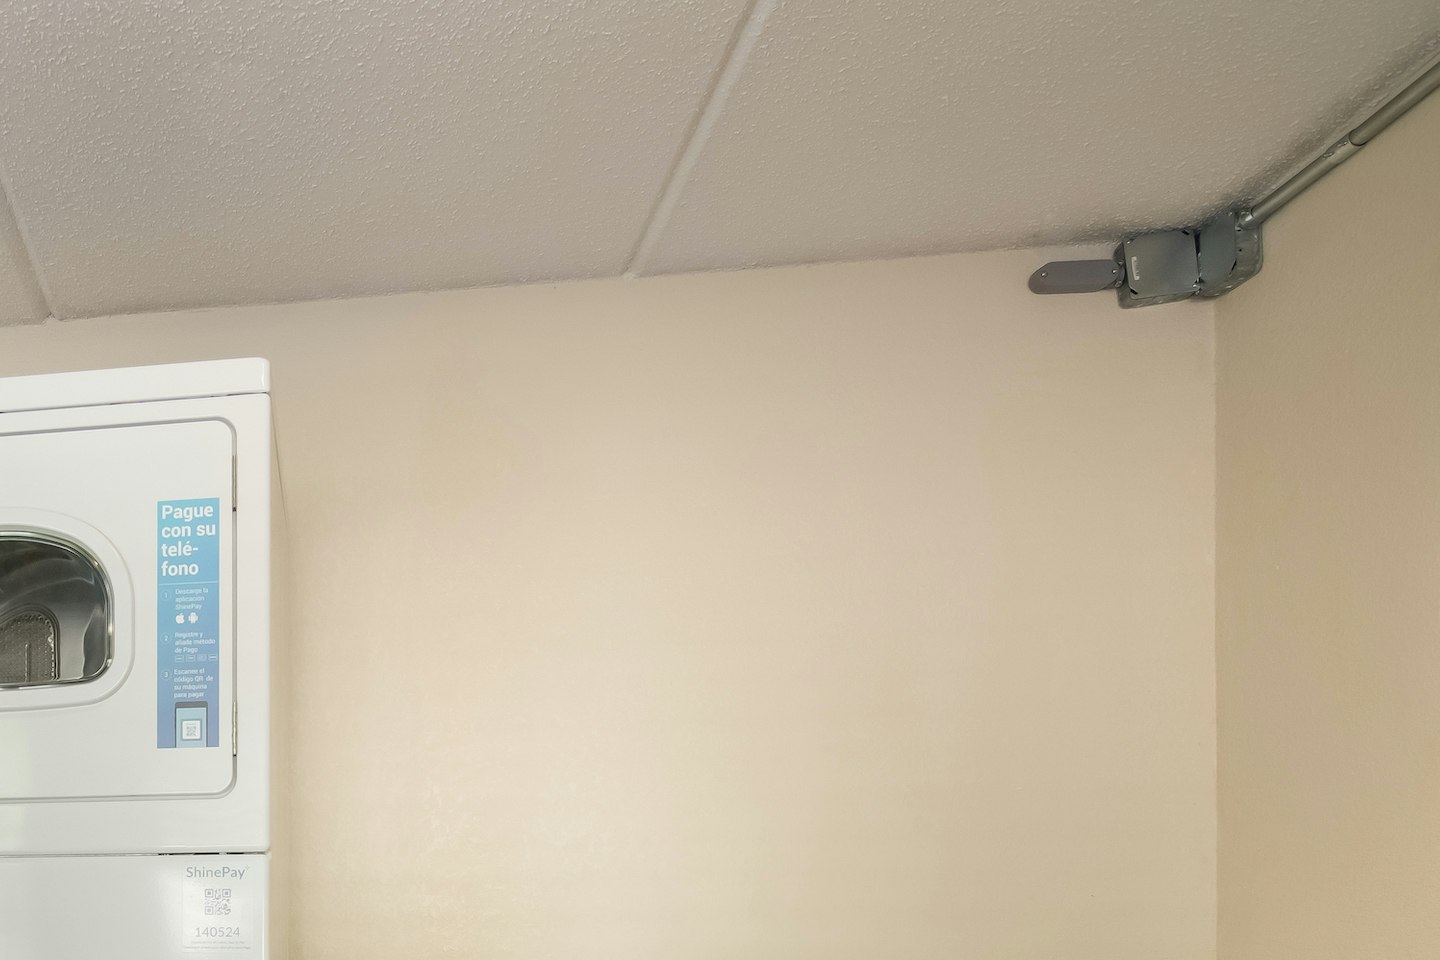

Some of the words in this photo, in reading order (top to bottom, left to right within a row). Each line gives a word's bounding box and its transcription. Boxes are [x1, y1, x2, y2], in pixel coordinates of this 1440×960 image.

[161, 503, 214, 522] Pague
[161, 526, 191, 539] con
[196, 523, 216, 536] su
[161, 540, 199, 557] telé-
[161, 560, 199, 577] fono
[186, 866, 245, 879] ShinePay
[195, 926, 240, 938] 140524
